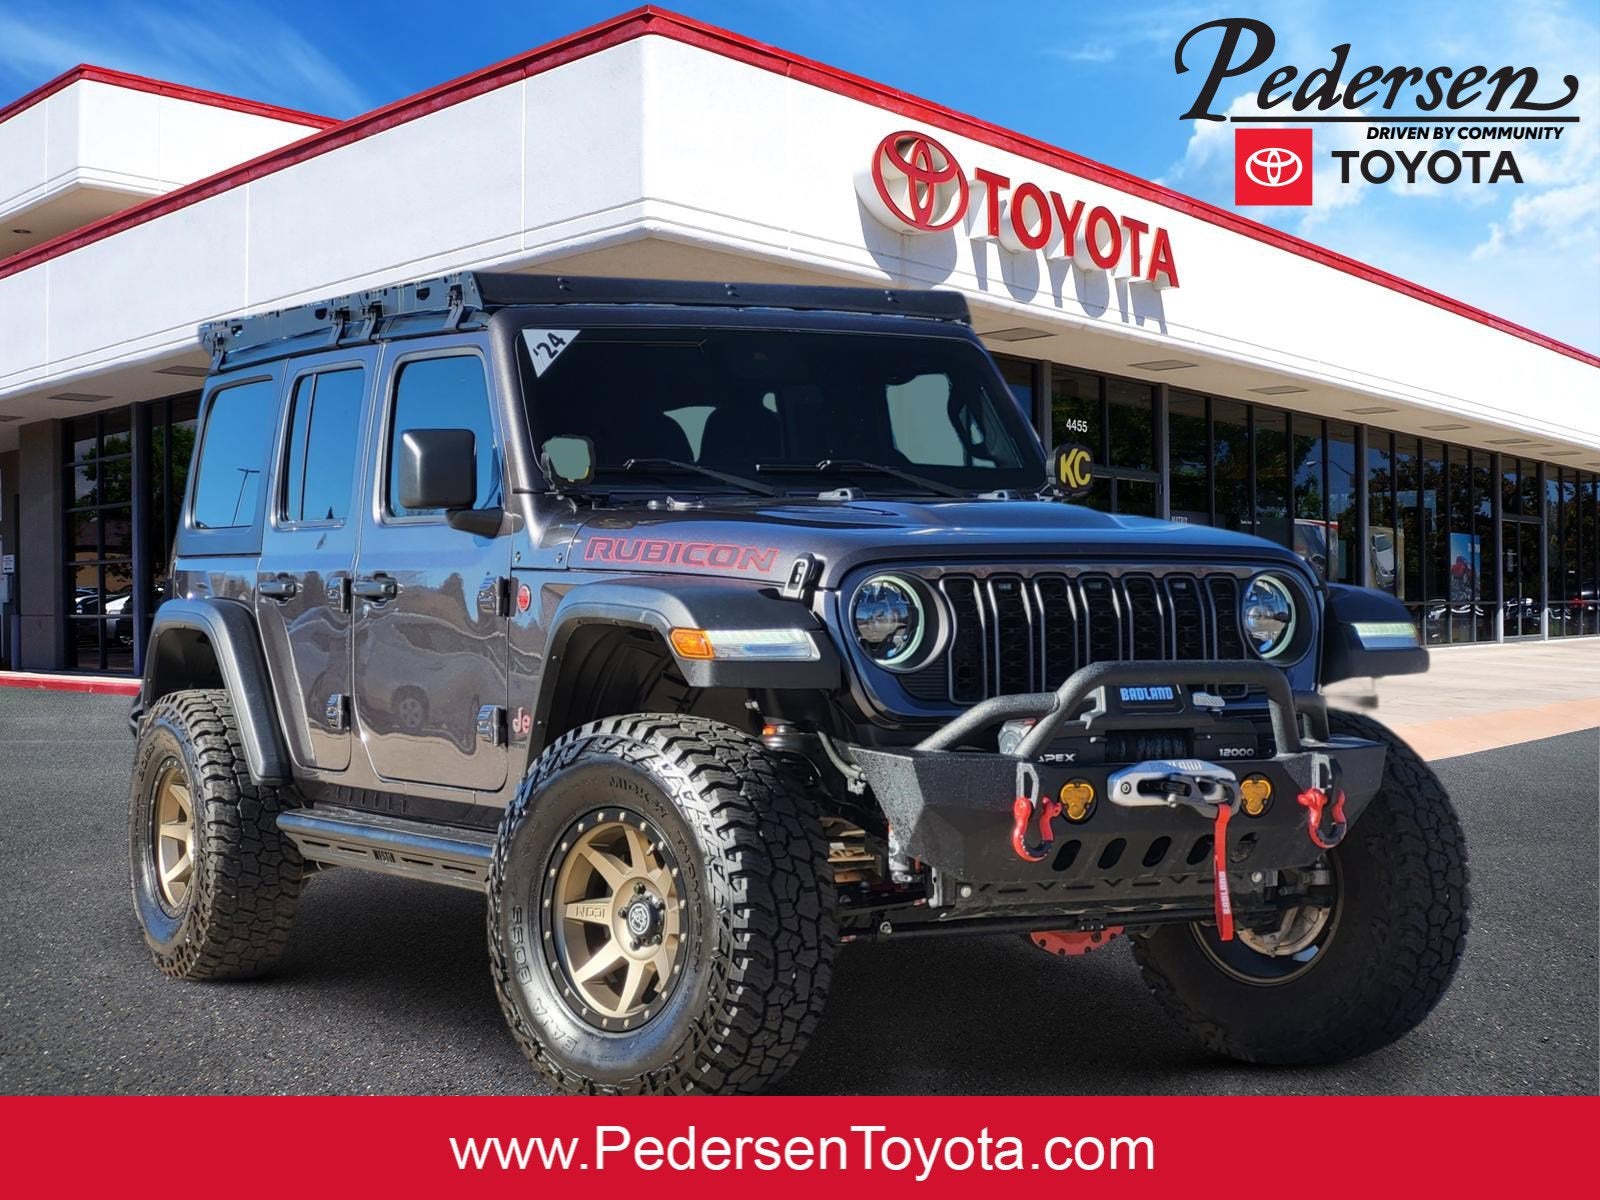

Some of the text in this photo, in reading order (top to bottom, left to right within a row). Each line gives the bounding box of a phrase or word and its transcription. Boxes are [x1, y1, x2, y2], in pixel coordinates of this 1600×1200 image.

[975, 167, 1180, 288] TOYOTA
[1066, 418, 1088, 433] 4455
[1060, 448, 1091, 489] KC
[584, 537, 780, 572] RUBICON
[1120, 686, 1174, 702] BADLAND
[1037, 753, 1077, 763] APEX
[1219, 748, 1256, 758] 12000
